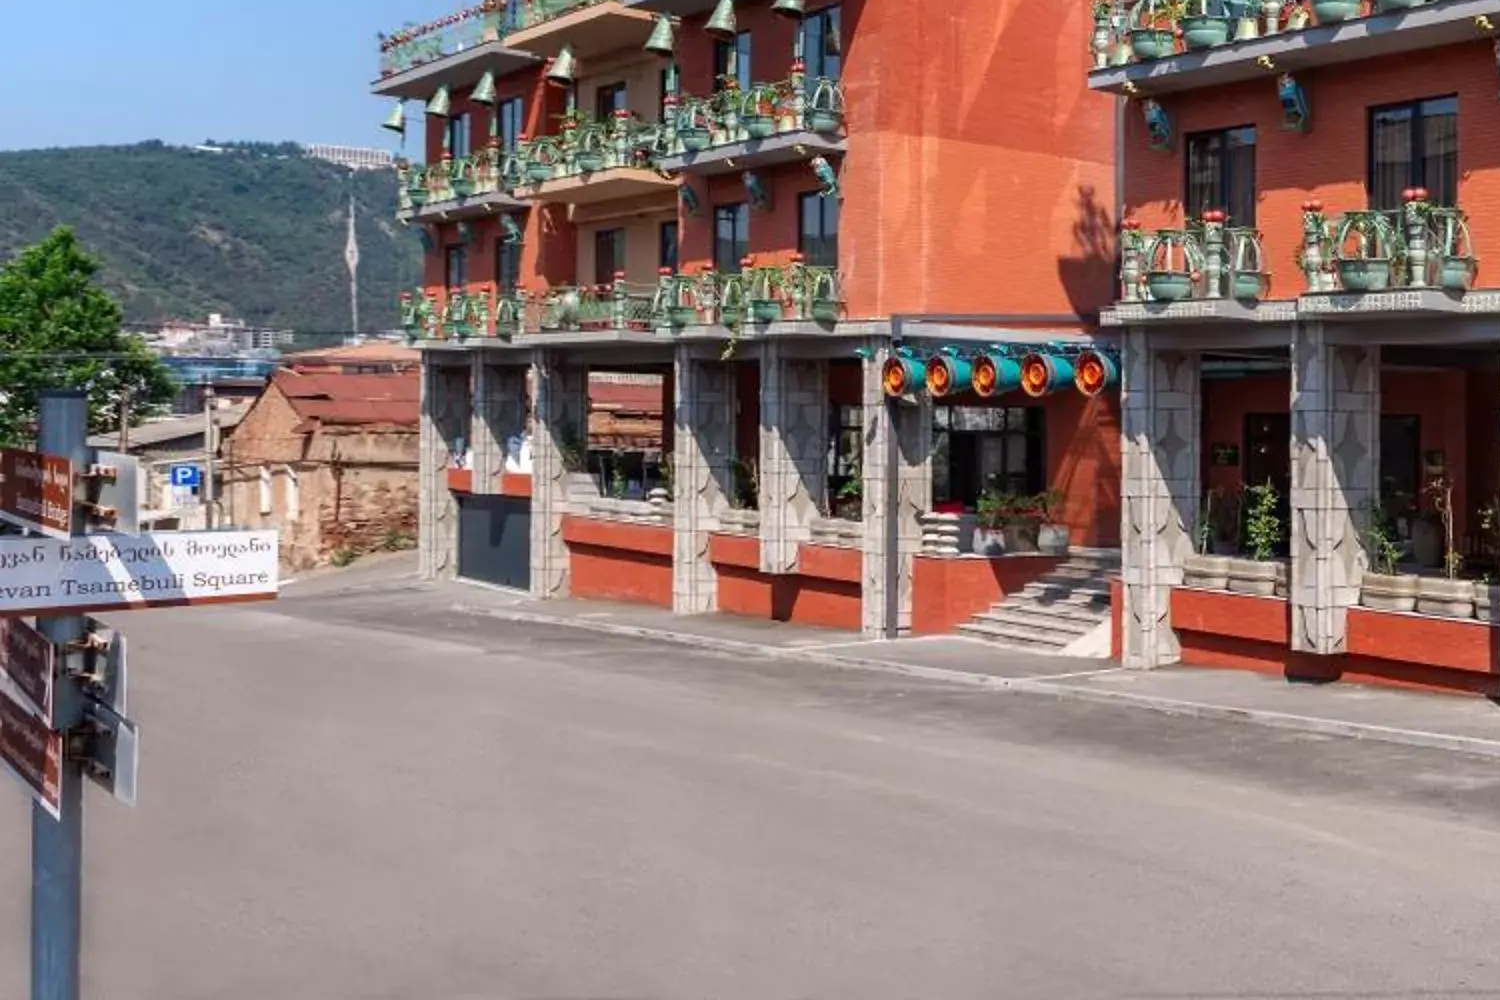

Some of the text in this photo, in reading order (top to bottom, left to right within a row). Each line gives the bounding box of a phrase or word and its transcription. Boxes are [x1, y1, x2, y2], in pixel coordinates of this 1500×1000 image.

[177, 467, 193, 484] P
[61, 573, 184, 596] Tsamebuli
[193, 570, 269, 590] Square
